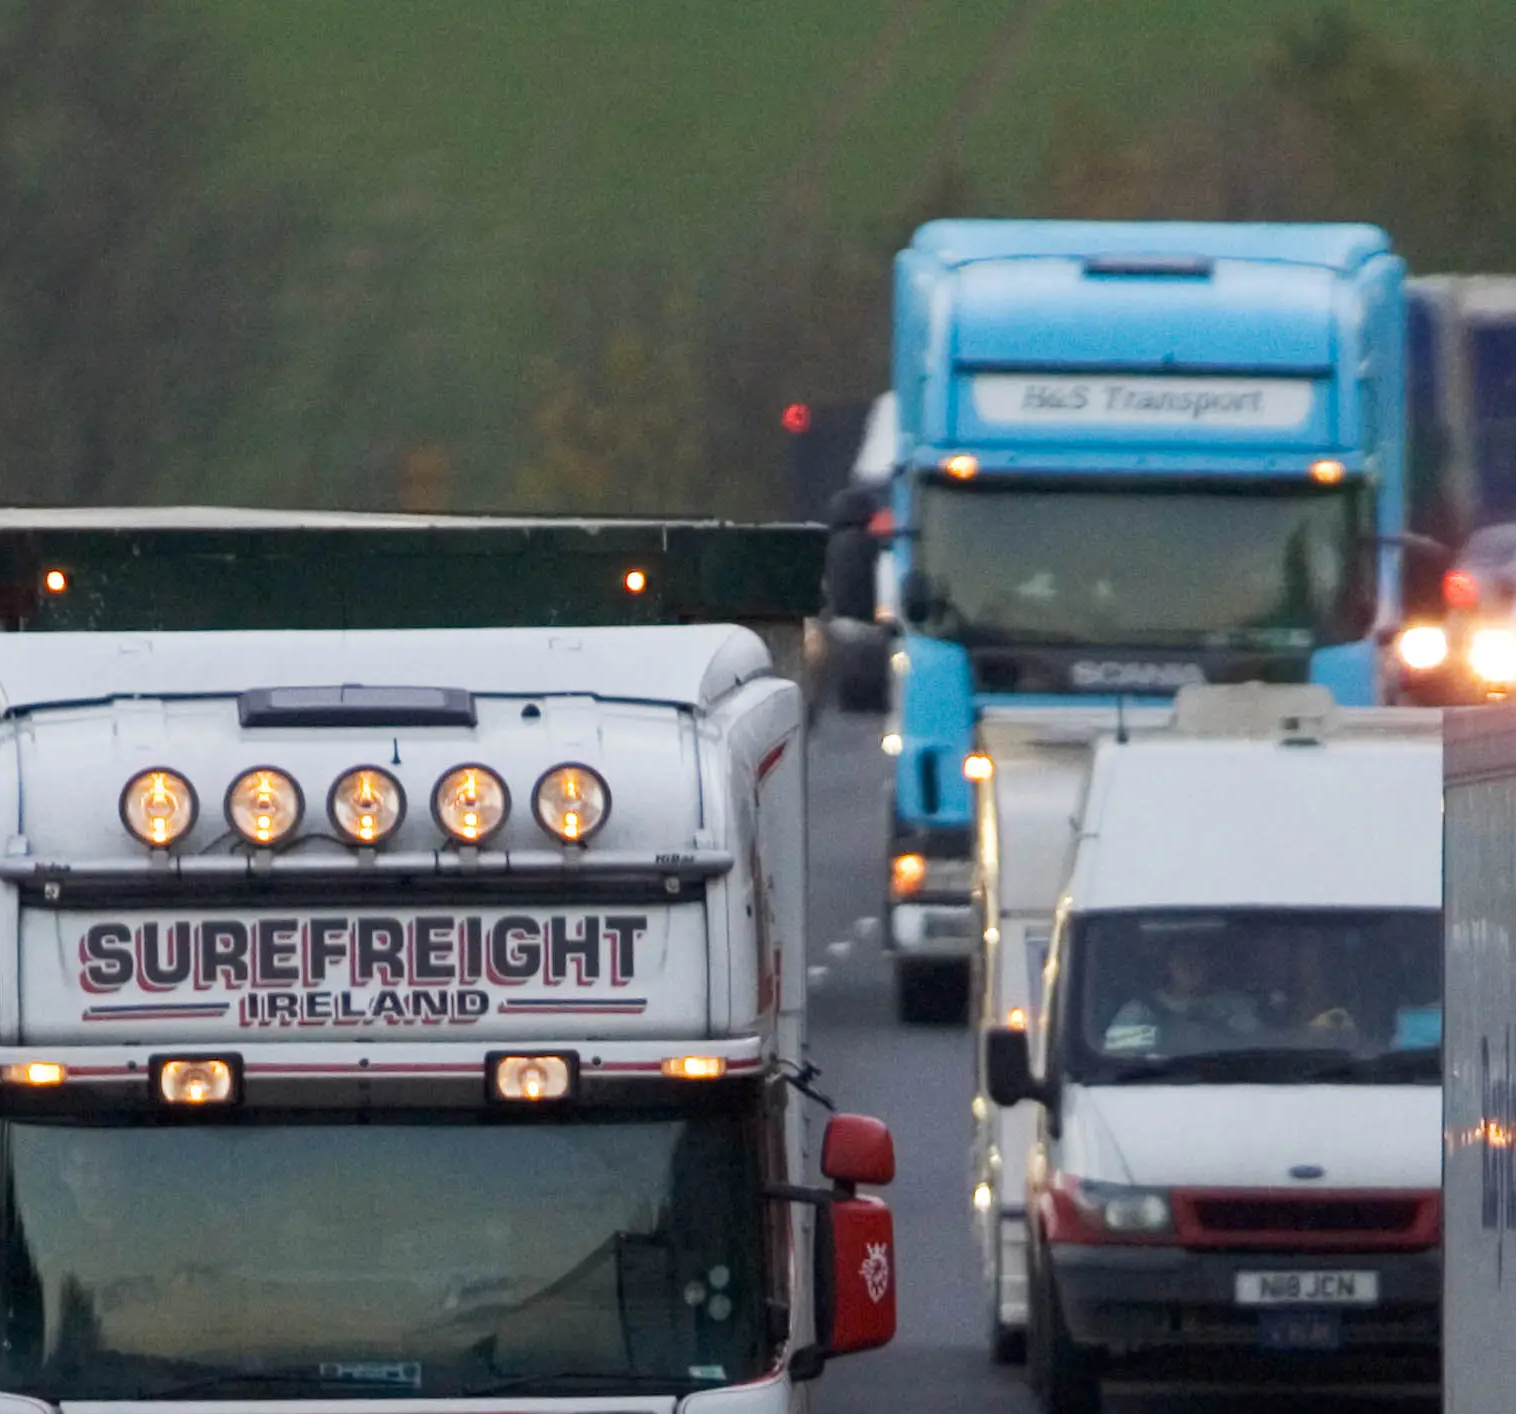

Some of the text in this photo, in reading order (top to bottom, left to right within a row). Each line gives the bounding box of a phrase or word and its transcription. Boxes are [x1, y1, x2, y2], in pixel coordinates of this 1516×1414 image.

[1101, 385, 1263, 418] Transport
[79, 914, 648, 992] SUREFREIGHT
[239, 989, 490, 1027] IRELAND
